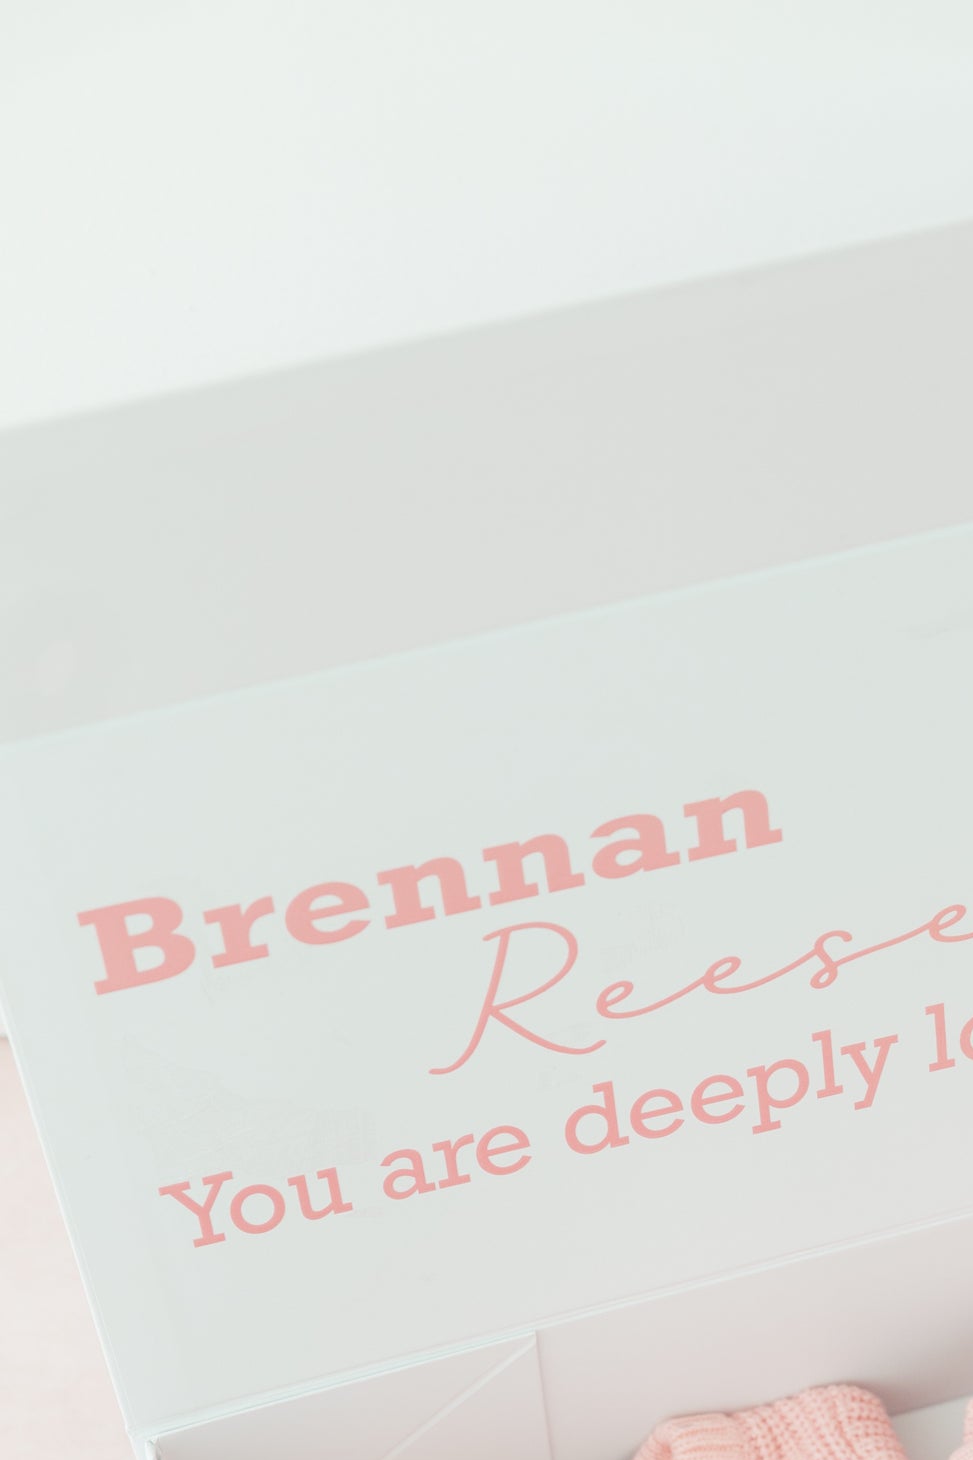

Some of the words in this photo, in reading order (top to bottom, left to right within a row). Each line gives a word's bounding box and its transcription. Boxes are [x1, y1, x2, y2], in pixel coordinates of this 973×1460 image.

[77, 788, 784, 996] Brennan
[158, 1167, 354, 1249] You
[379, 1124, 533, 1202] are
[563, 1029, 900, 1155] deeply
